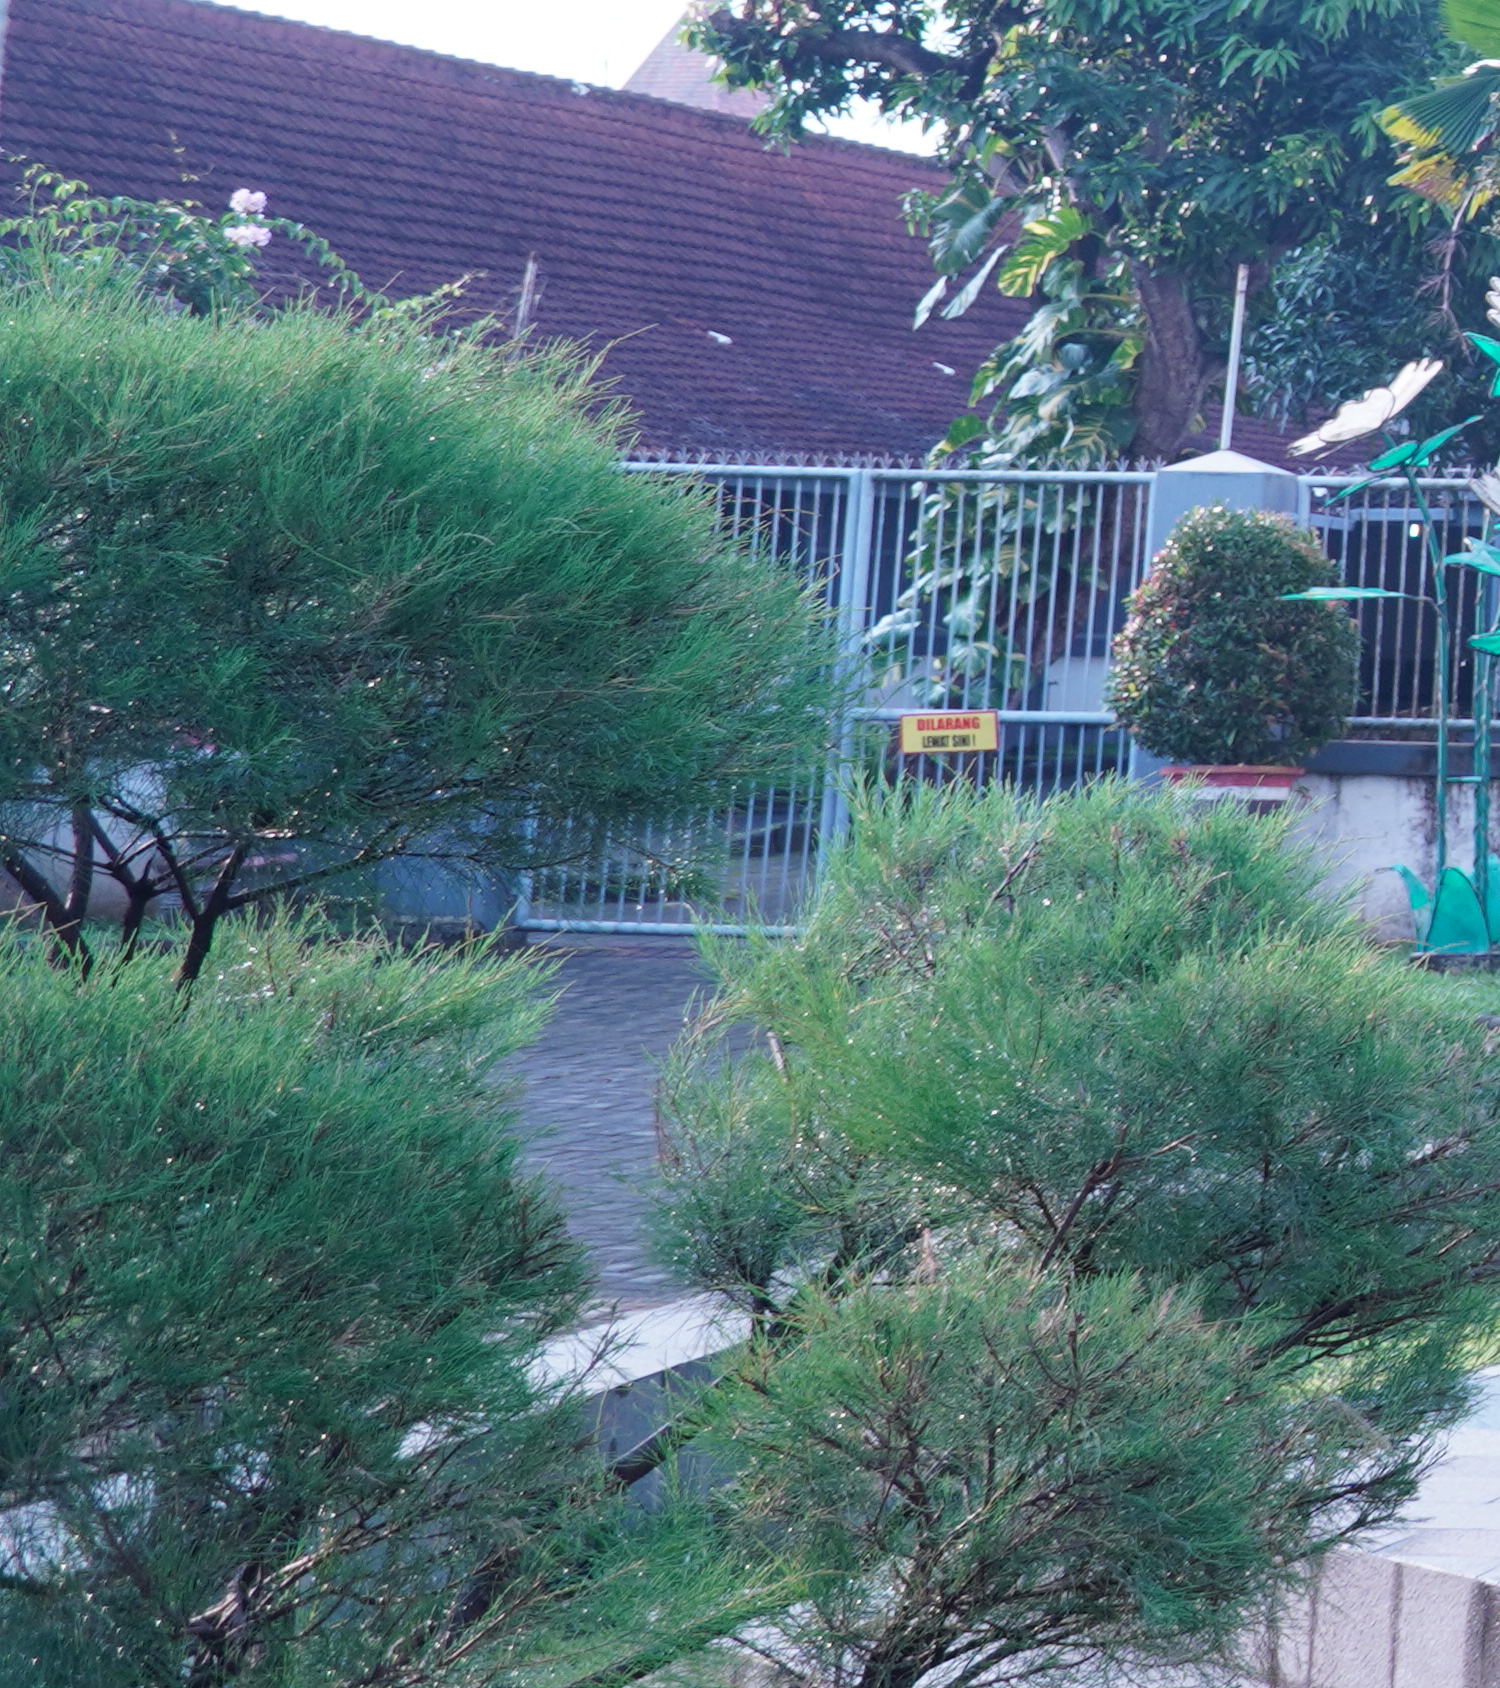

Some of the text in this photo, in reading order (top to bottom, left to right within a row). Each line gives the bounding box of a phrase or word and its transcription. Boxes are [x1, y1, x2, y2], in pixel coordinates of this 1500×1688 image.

[917, 717, 980, 731] DILARANG
[922, 735, 949, 748] LEWAT
[952, 734, 971, 748] SINI
